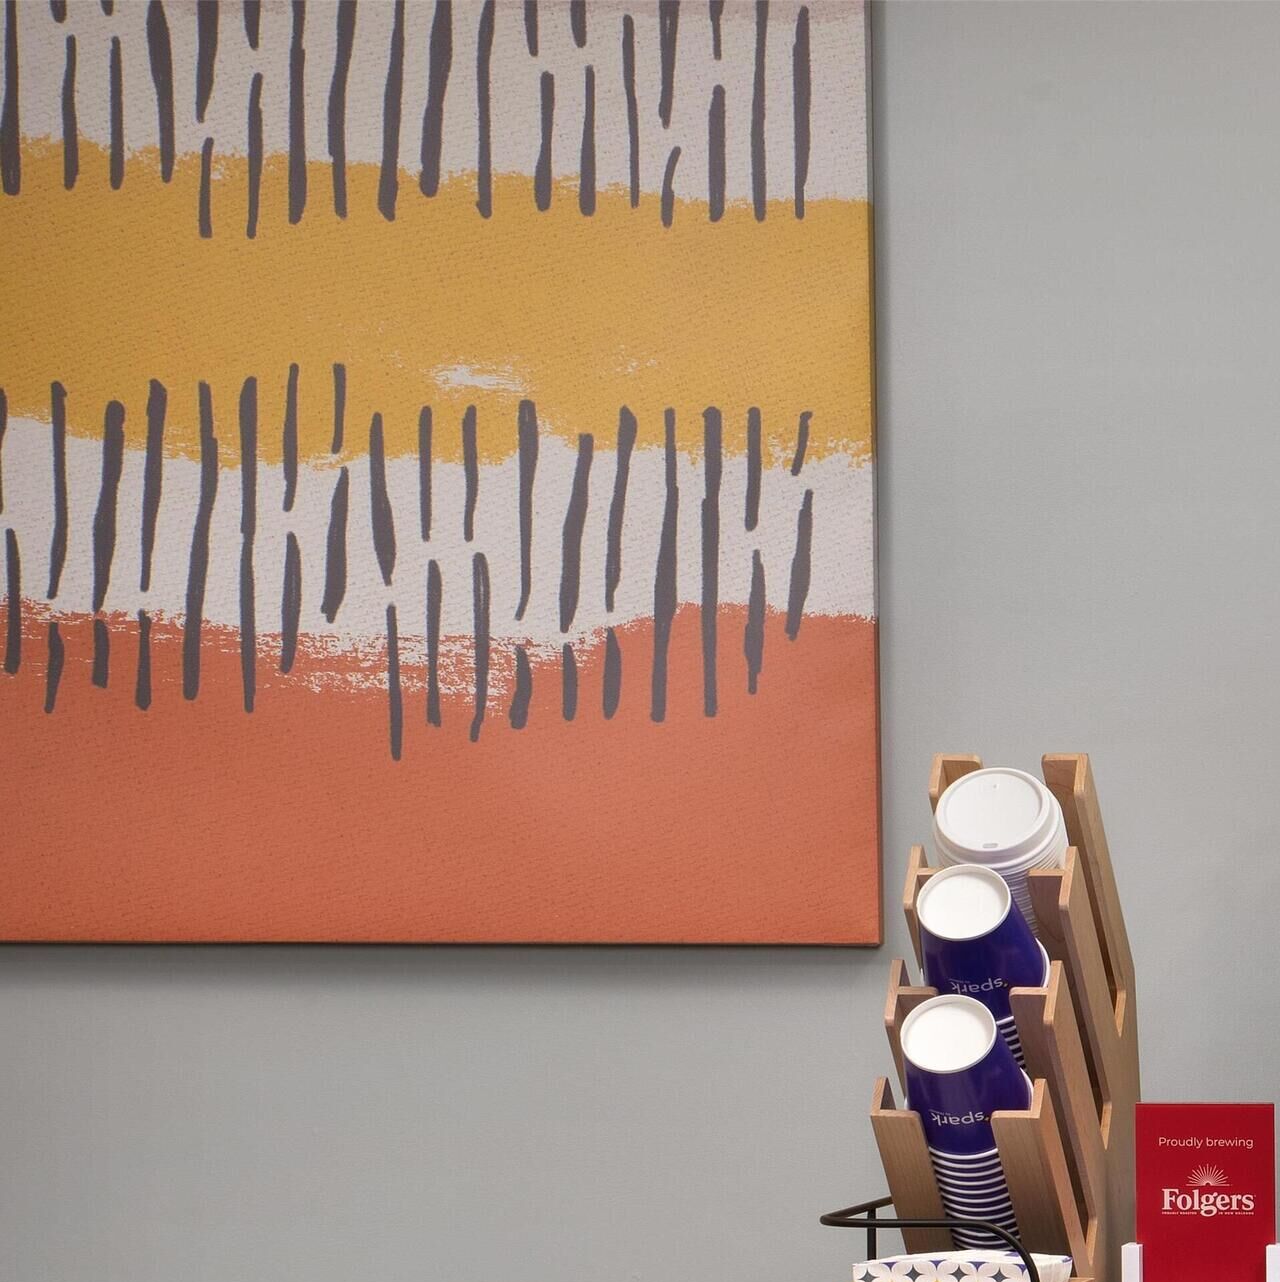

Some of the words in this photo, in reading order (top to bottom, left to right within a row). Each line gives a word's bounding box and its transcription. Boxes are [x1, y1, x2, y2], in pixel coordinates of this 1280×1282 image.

[930, 1111, 984, 1126] spark
[1158, 1136, 1203, 1149] Proudly
[1206, 1136, 1254, 1150] brewing
[1161, 1188, 1255, 1217] Folgers
